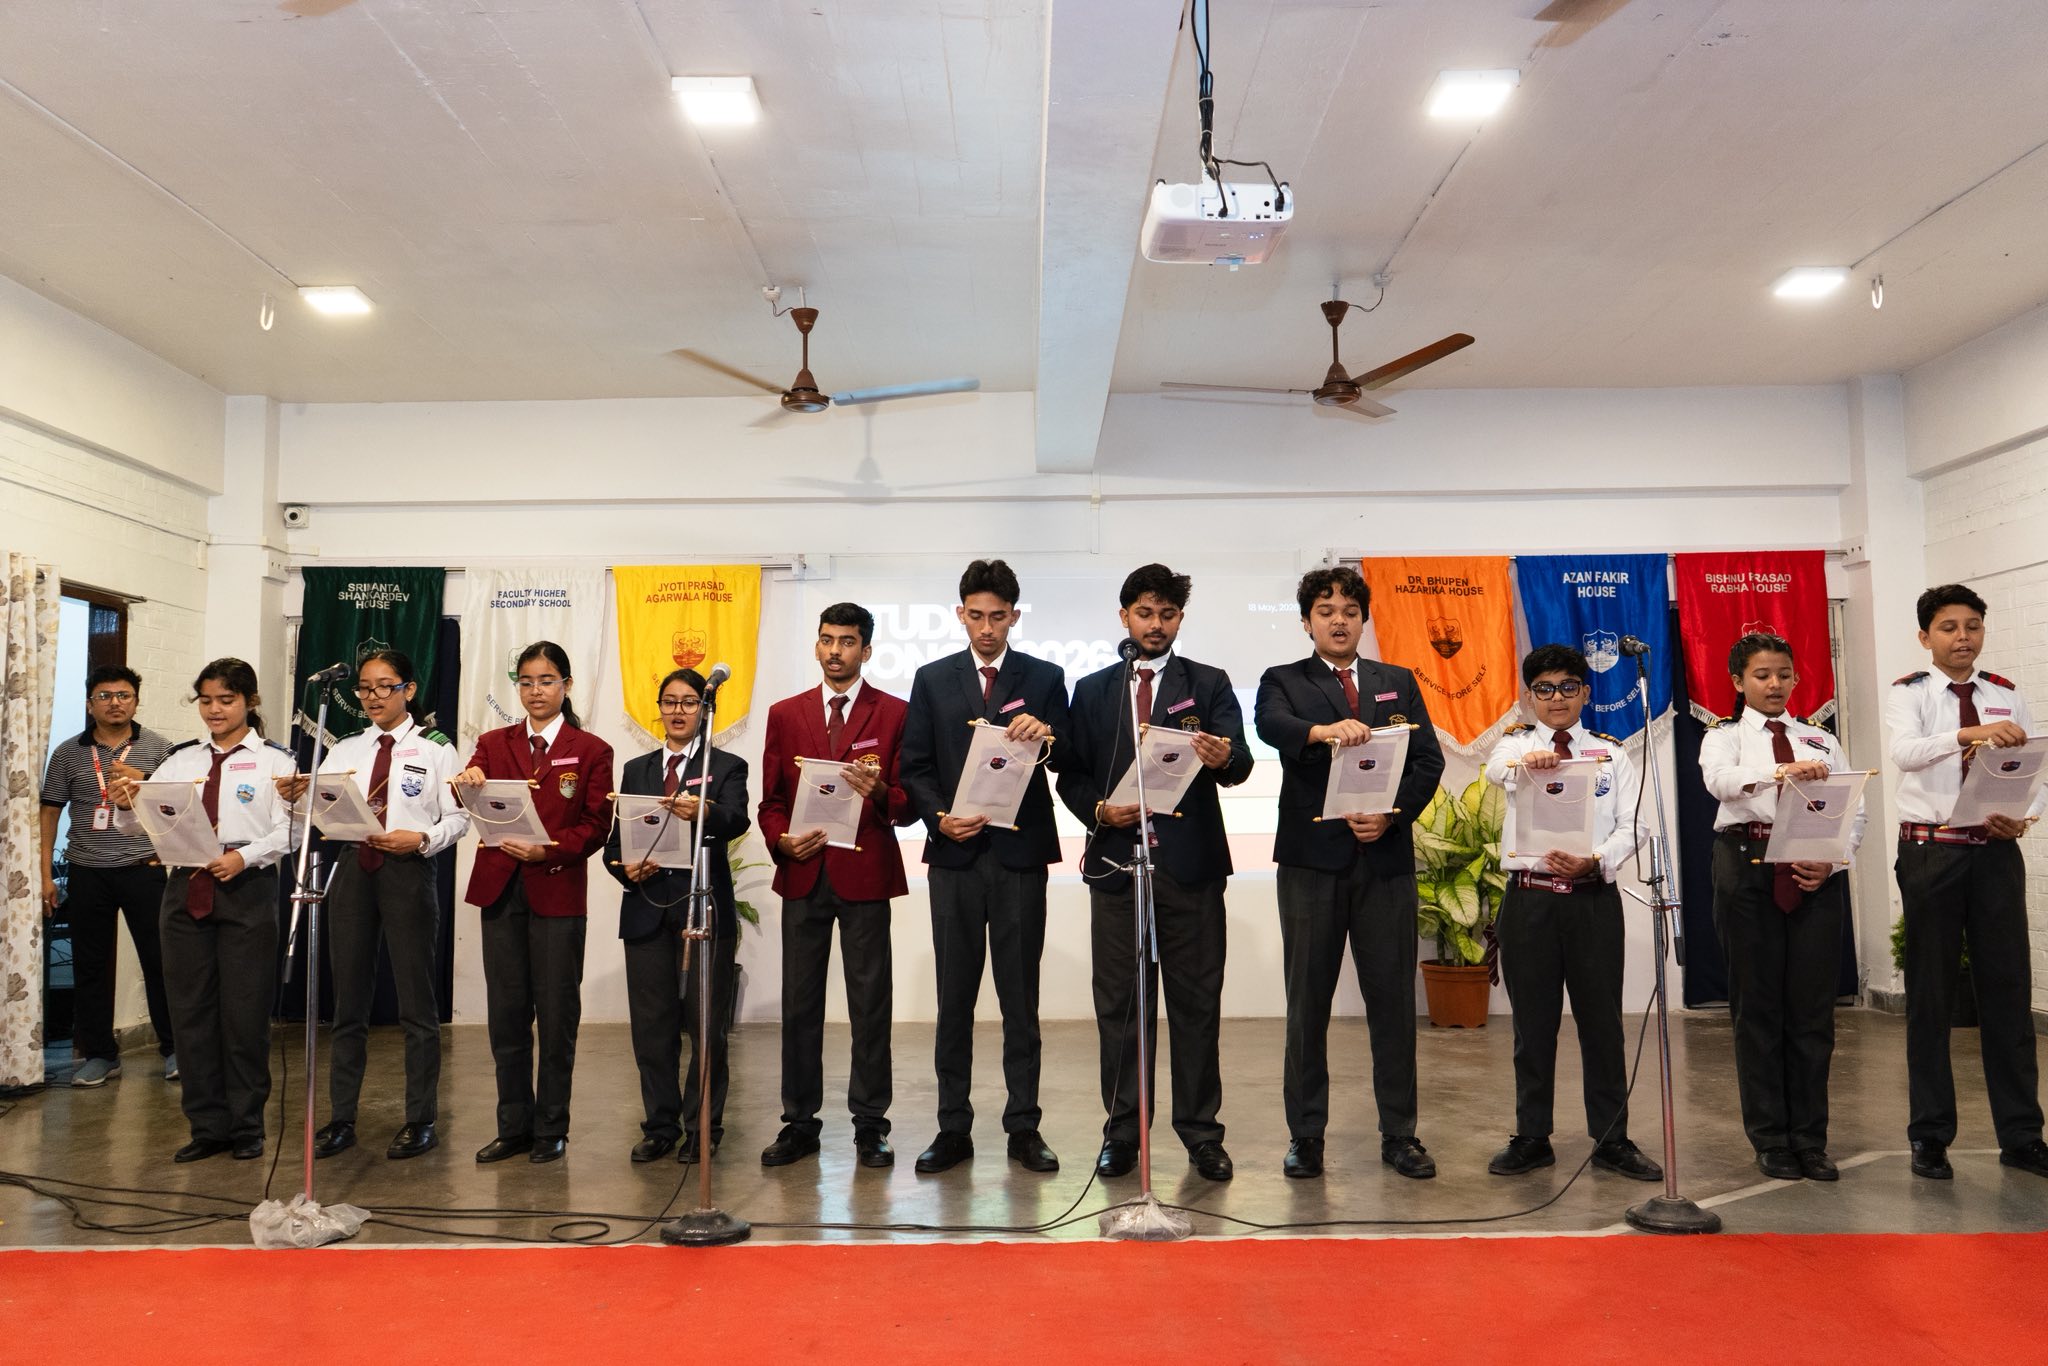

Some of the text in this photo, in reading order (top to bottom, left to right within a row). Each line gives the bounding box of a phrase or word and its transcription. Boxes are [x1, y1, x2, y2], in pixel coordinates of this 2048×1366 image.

[1427, 576, 1469, 587] BHUPEN
[1563, 571, 1629, 584] AZAN FAKIR
[1705, 573, 1745, 583] BISHNU
[658, 581, 725, 592] JYOTI PRASAD
[1395, 585, 1484, 596] HAZARIKA HOUSE
[1577, 585, 1616, 598] HOUSE
[1711, 583, 1749, 593] RABHA
[497, 589, 567, 599] FACULTY HIGHER
[645, 592, 733, 603] AGARWALA HOUSE
[356, 600, 390, 609] HOUSE
[490, 599, 572, 608] SECONDARY SCHOOL
[1248, 603, 1257, 611] 18
[1258, 603, 1278, 613] May,
[1414, 667, 1447, 696] SERVICE
[1471, 664, 1487, 687] SELF
[332, 688, 357, 717] SERVICE
[1595, 699, 1627, 712] BEFORE
[486, 694, 513, 723] SERVICE
